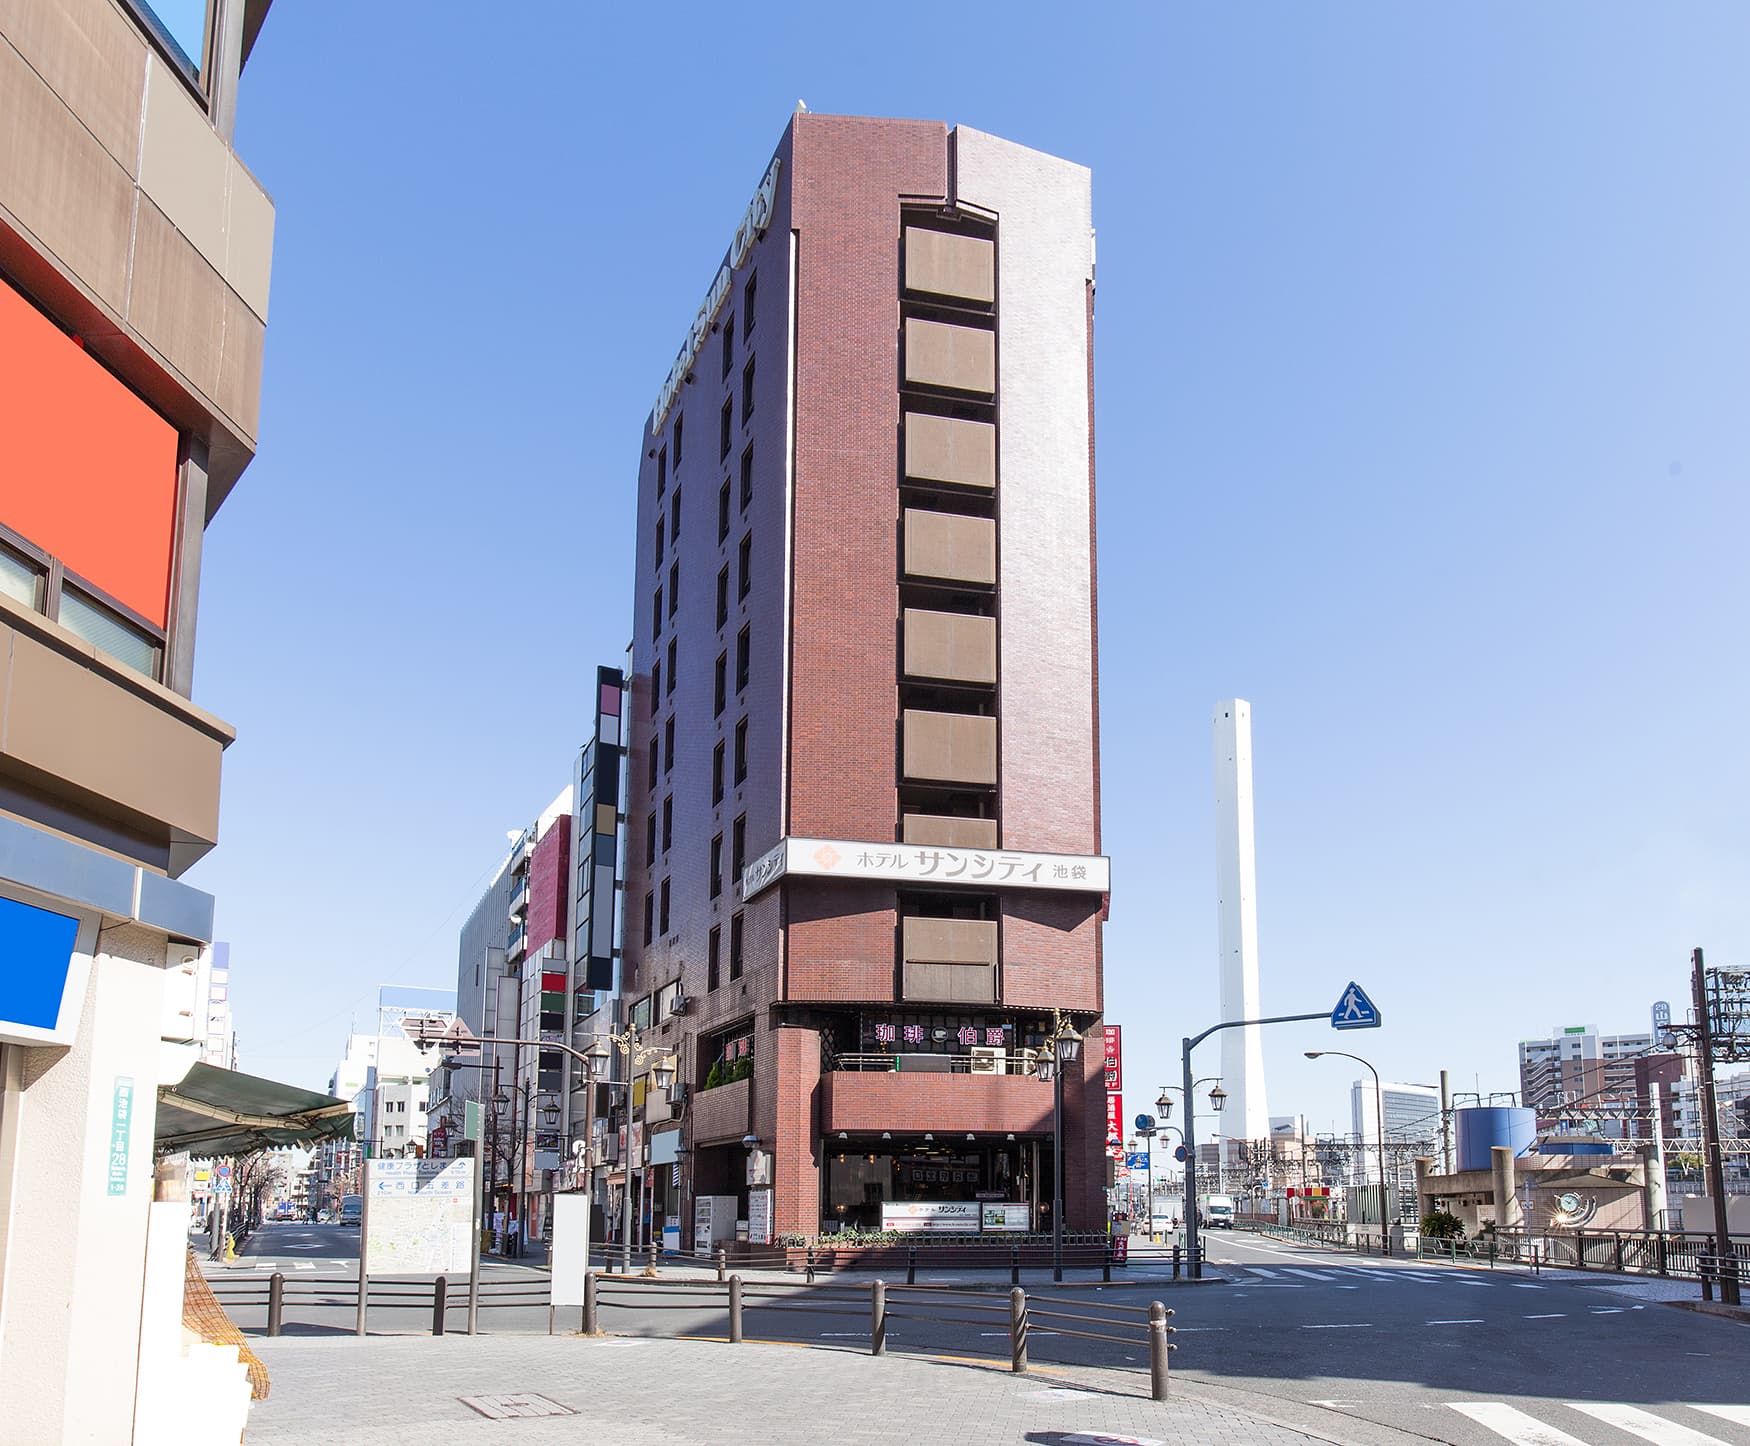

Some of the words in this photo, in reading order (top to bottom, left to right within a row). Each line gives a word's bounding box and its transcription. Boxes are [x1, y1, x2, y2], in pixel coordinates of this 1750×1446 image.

[856, 851, 909, 870] ホテル
[914, 849, 1044, 883] サンシティ
[1052, 863, 1088, 881] 池袋
[875, 1023, 925, 1044] 珈琲
[958, 1026, 1005, 1046] 伯爵
[111, 1153, 126, 1166] 28
